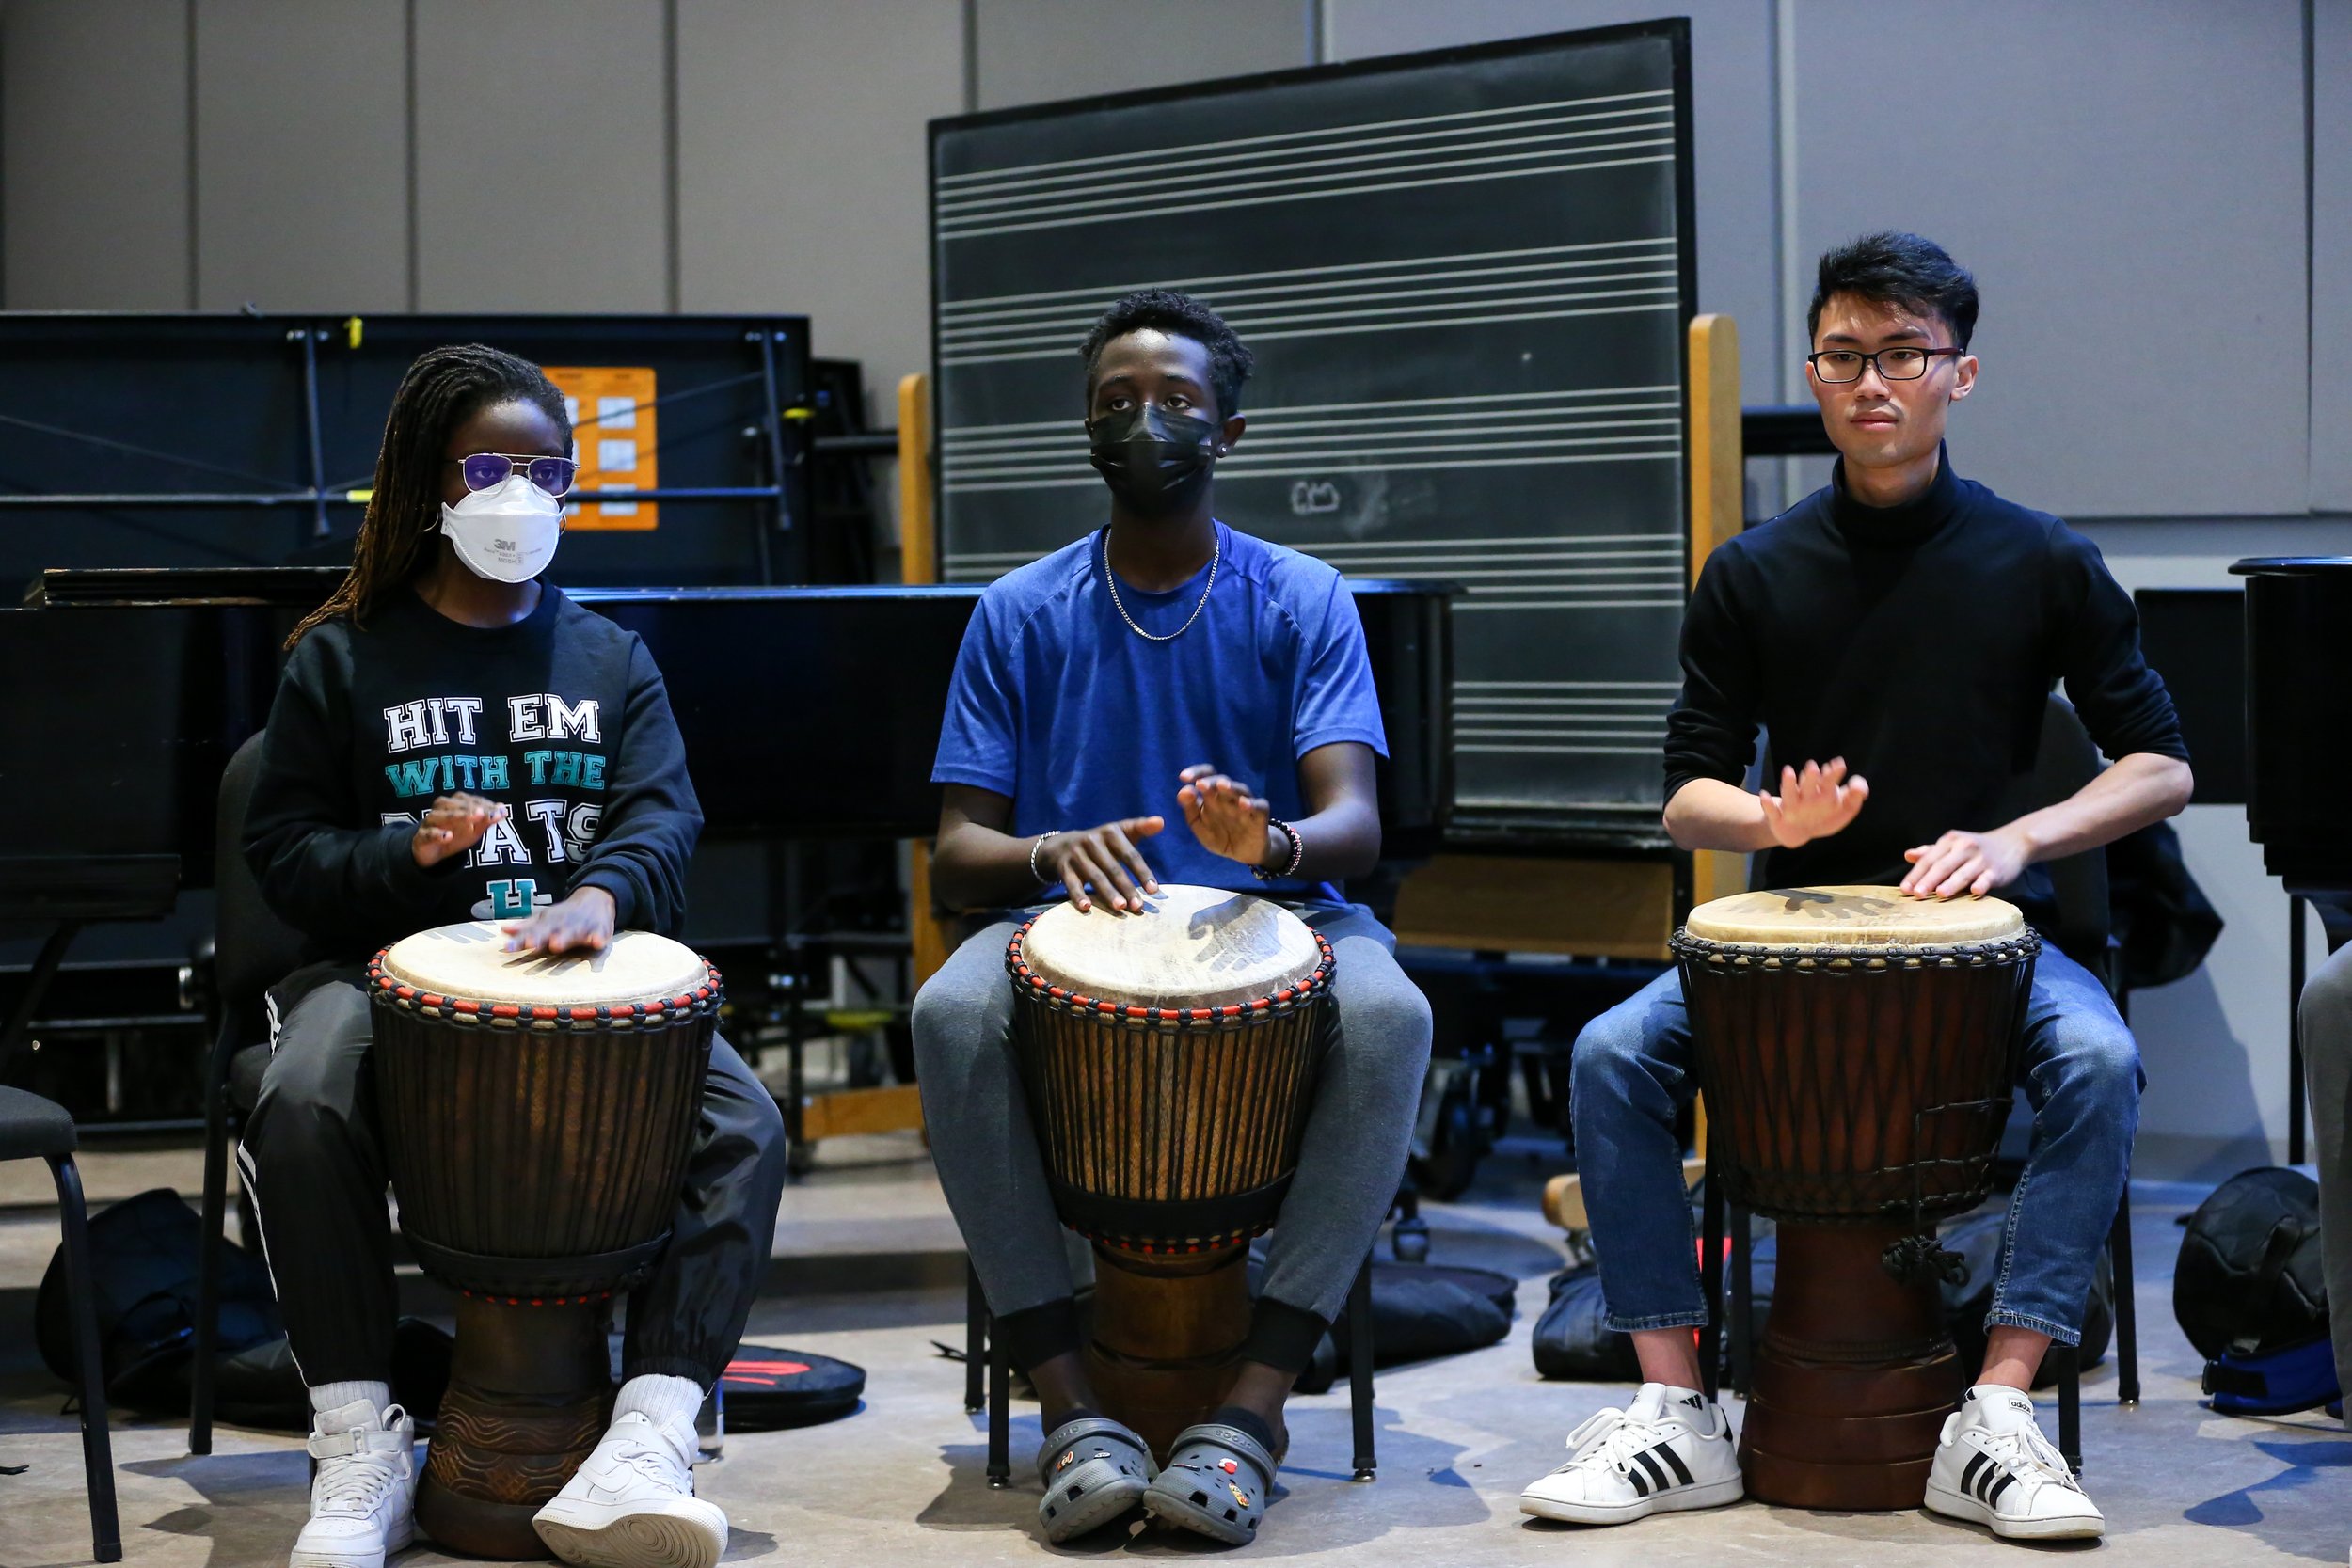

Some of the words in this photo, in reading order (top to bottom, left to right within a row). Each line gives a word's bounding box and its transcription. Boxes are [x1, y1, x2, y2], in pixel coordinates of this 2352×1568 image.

[494, 538, 516, 551] 3M
[383, 697, 483, 753] HIT
[507, 693, 601, 744] EM
[385, 755, 510, 798] WITH
[524, 751, 606, 789] THE
[381, 800, 603, 869] ATS
